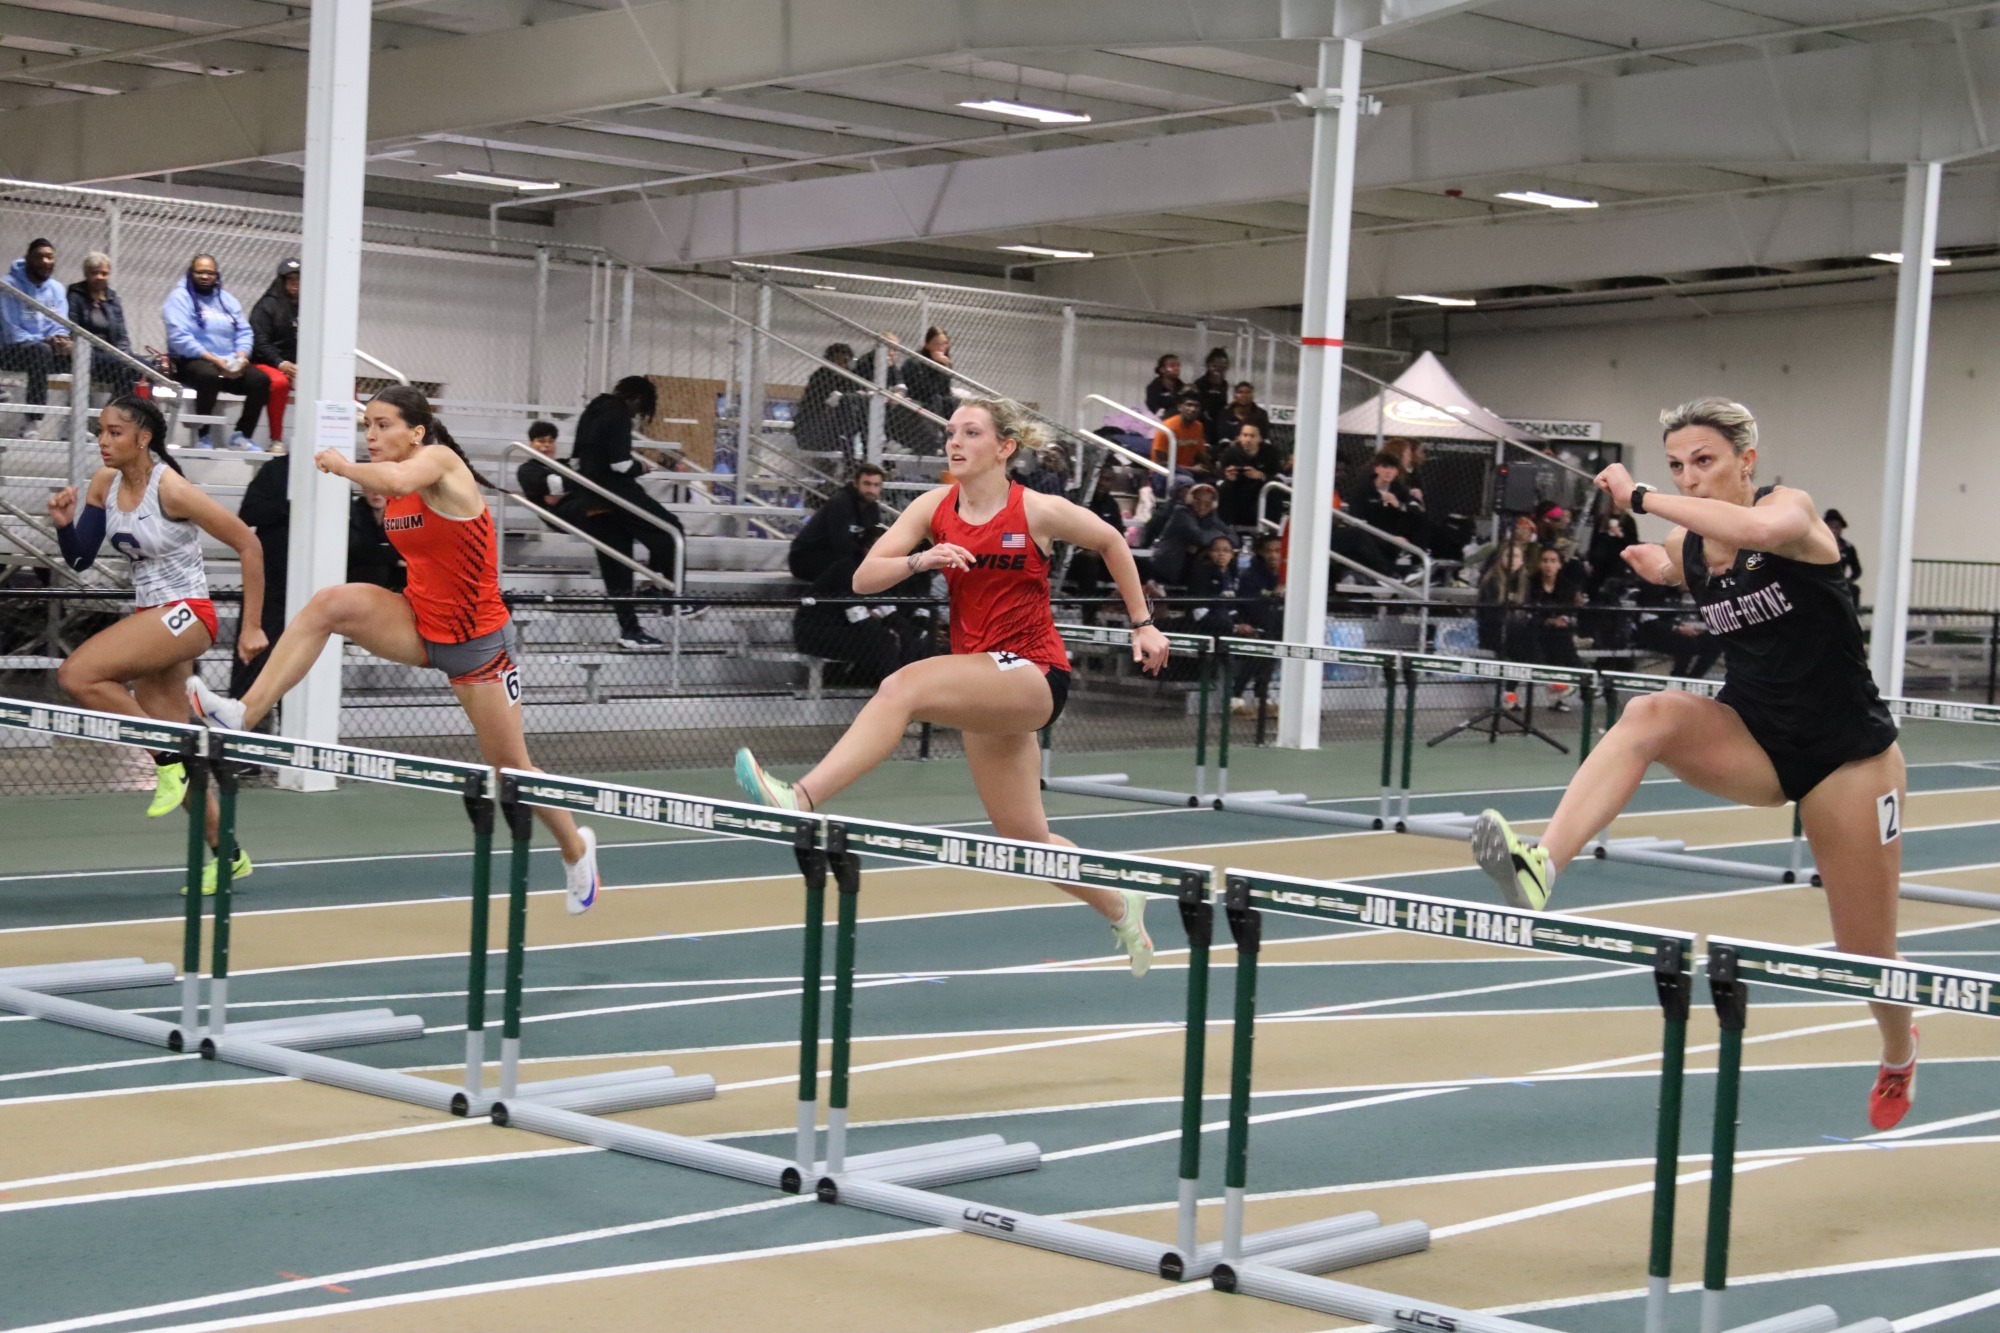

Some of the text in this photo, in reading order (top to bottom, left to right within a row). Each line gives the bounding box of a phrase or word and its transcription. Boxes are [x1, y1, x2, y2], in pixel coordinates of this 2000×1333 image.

[1506, 421, 1592, 437] RCHANDISE
[385, 514, 424, 531] SCULUM
[167, 607, 192, 630] 8
[1700, 581, 1793, 635] ENOIR-RHYNE
[506, 671, 519, 701] 6
[318, 748, 350, 773] FAST
[353, 752, 396, 780] TRACK
[594, 789, 620, 815] JDL
[626, 793, 661, 821] FAST
[666, 799, 715, 829] TRACK
[1884, 795, 1897, 840] 2
[865, 833, 900, 848] UCS
[937, 837, 970, 866] JDL
[975, 841, 1016, 873] FAST
[1024, 848, 1080, 880] TRACK
[1120, 869, 1162, 885] UCS
[1271, 891, 1316, 907] UCS
[1360, 895, 1399, 928] JDL
[1405, 901, 1456, 936] FAST
[1464, 908, 1535, 947] TRACK
[1583, 935, 1632, 953] UCS
[1765, 961, 1819, 980] UCS
[1873, 968, 1921, 1003] JDL
[1931, 975, 1992, 1012] FAST
[963, 1207, 1018, 1232] UCS
[1394, 1308, 1460, 1333] UCS
